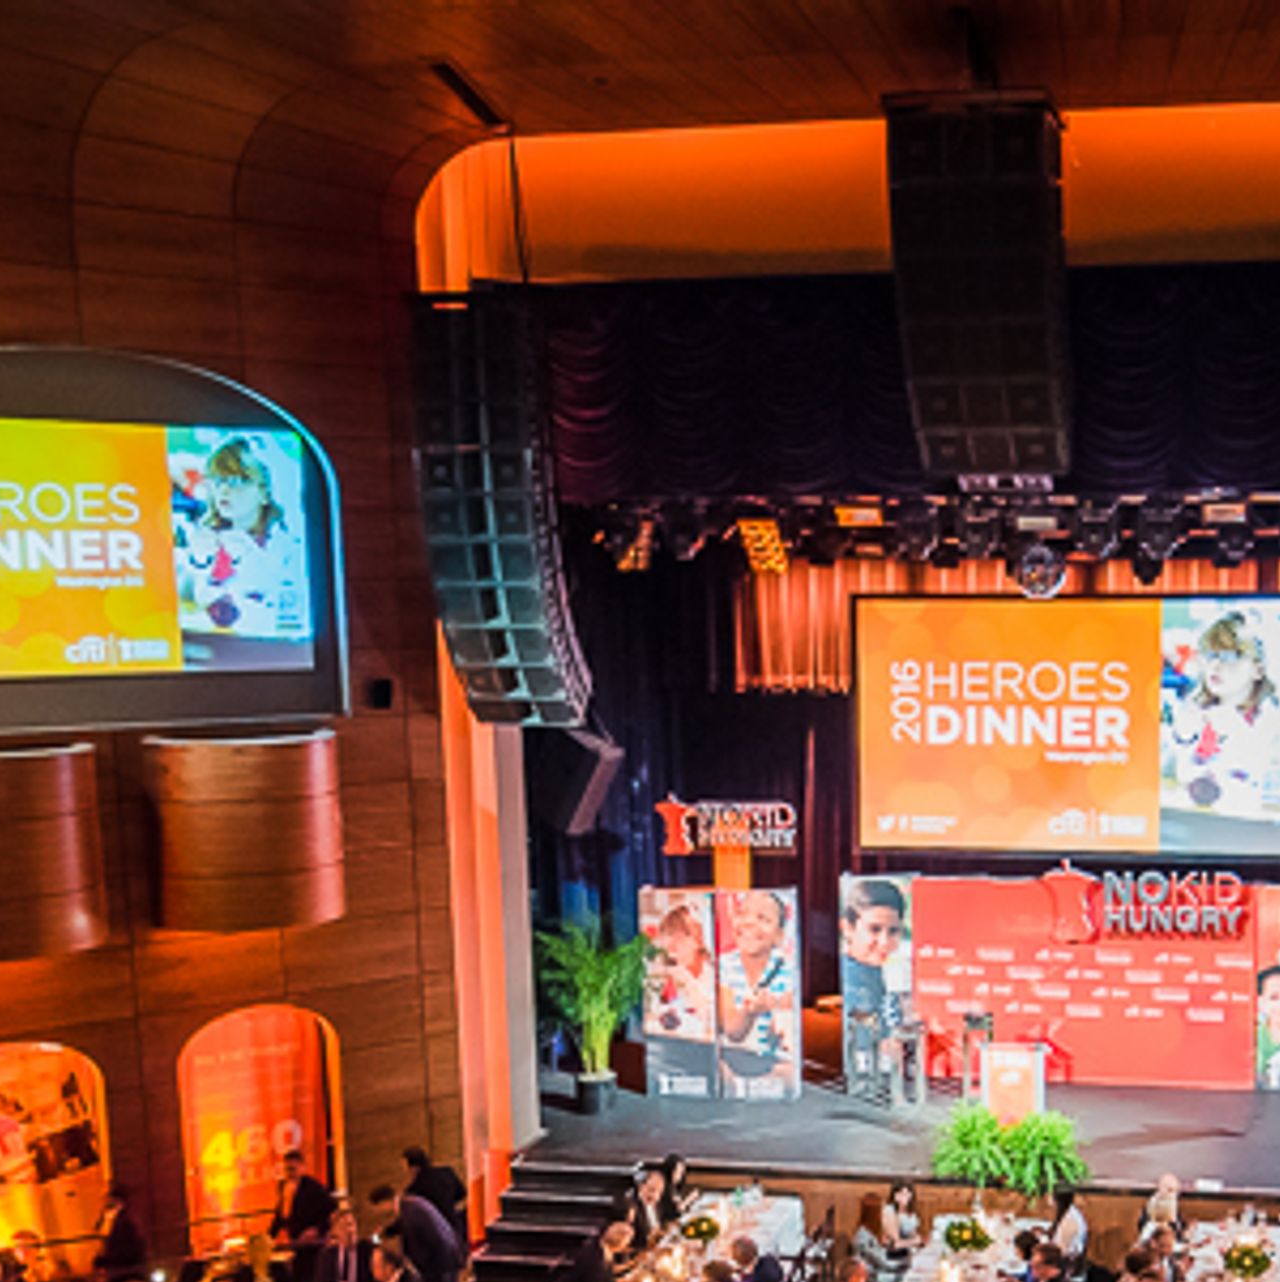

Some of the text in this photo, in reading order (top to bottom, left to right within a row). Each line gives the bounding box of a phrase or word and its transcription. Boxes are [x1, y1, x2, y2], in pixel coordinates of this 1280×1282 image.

[890, 657, 920, 743] 2016
[924, 660, 1132, 702] HEROES
[925, 704, 1131, 747] DINNER
[1104, 904, 1243, 933] HUNGRY
[202, 1118, 303, 1168] 460
